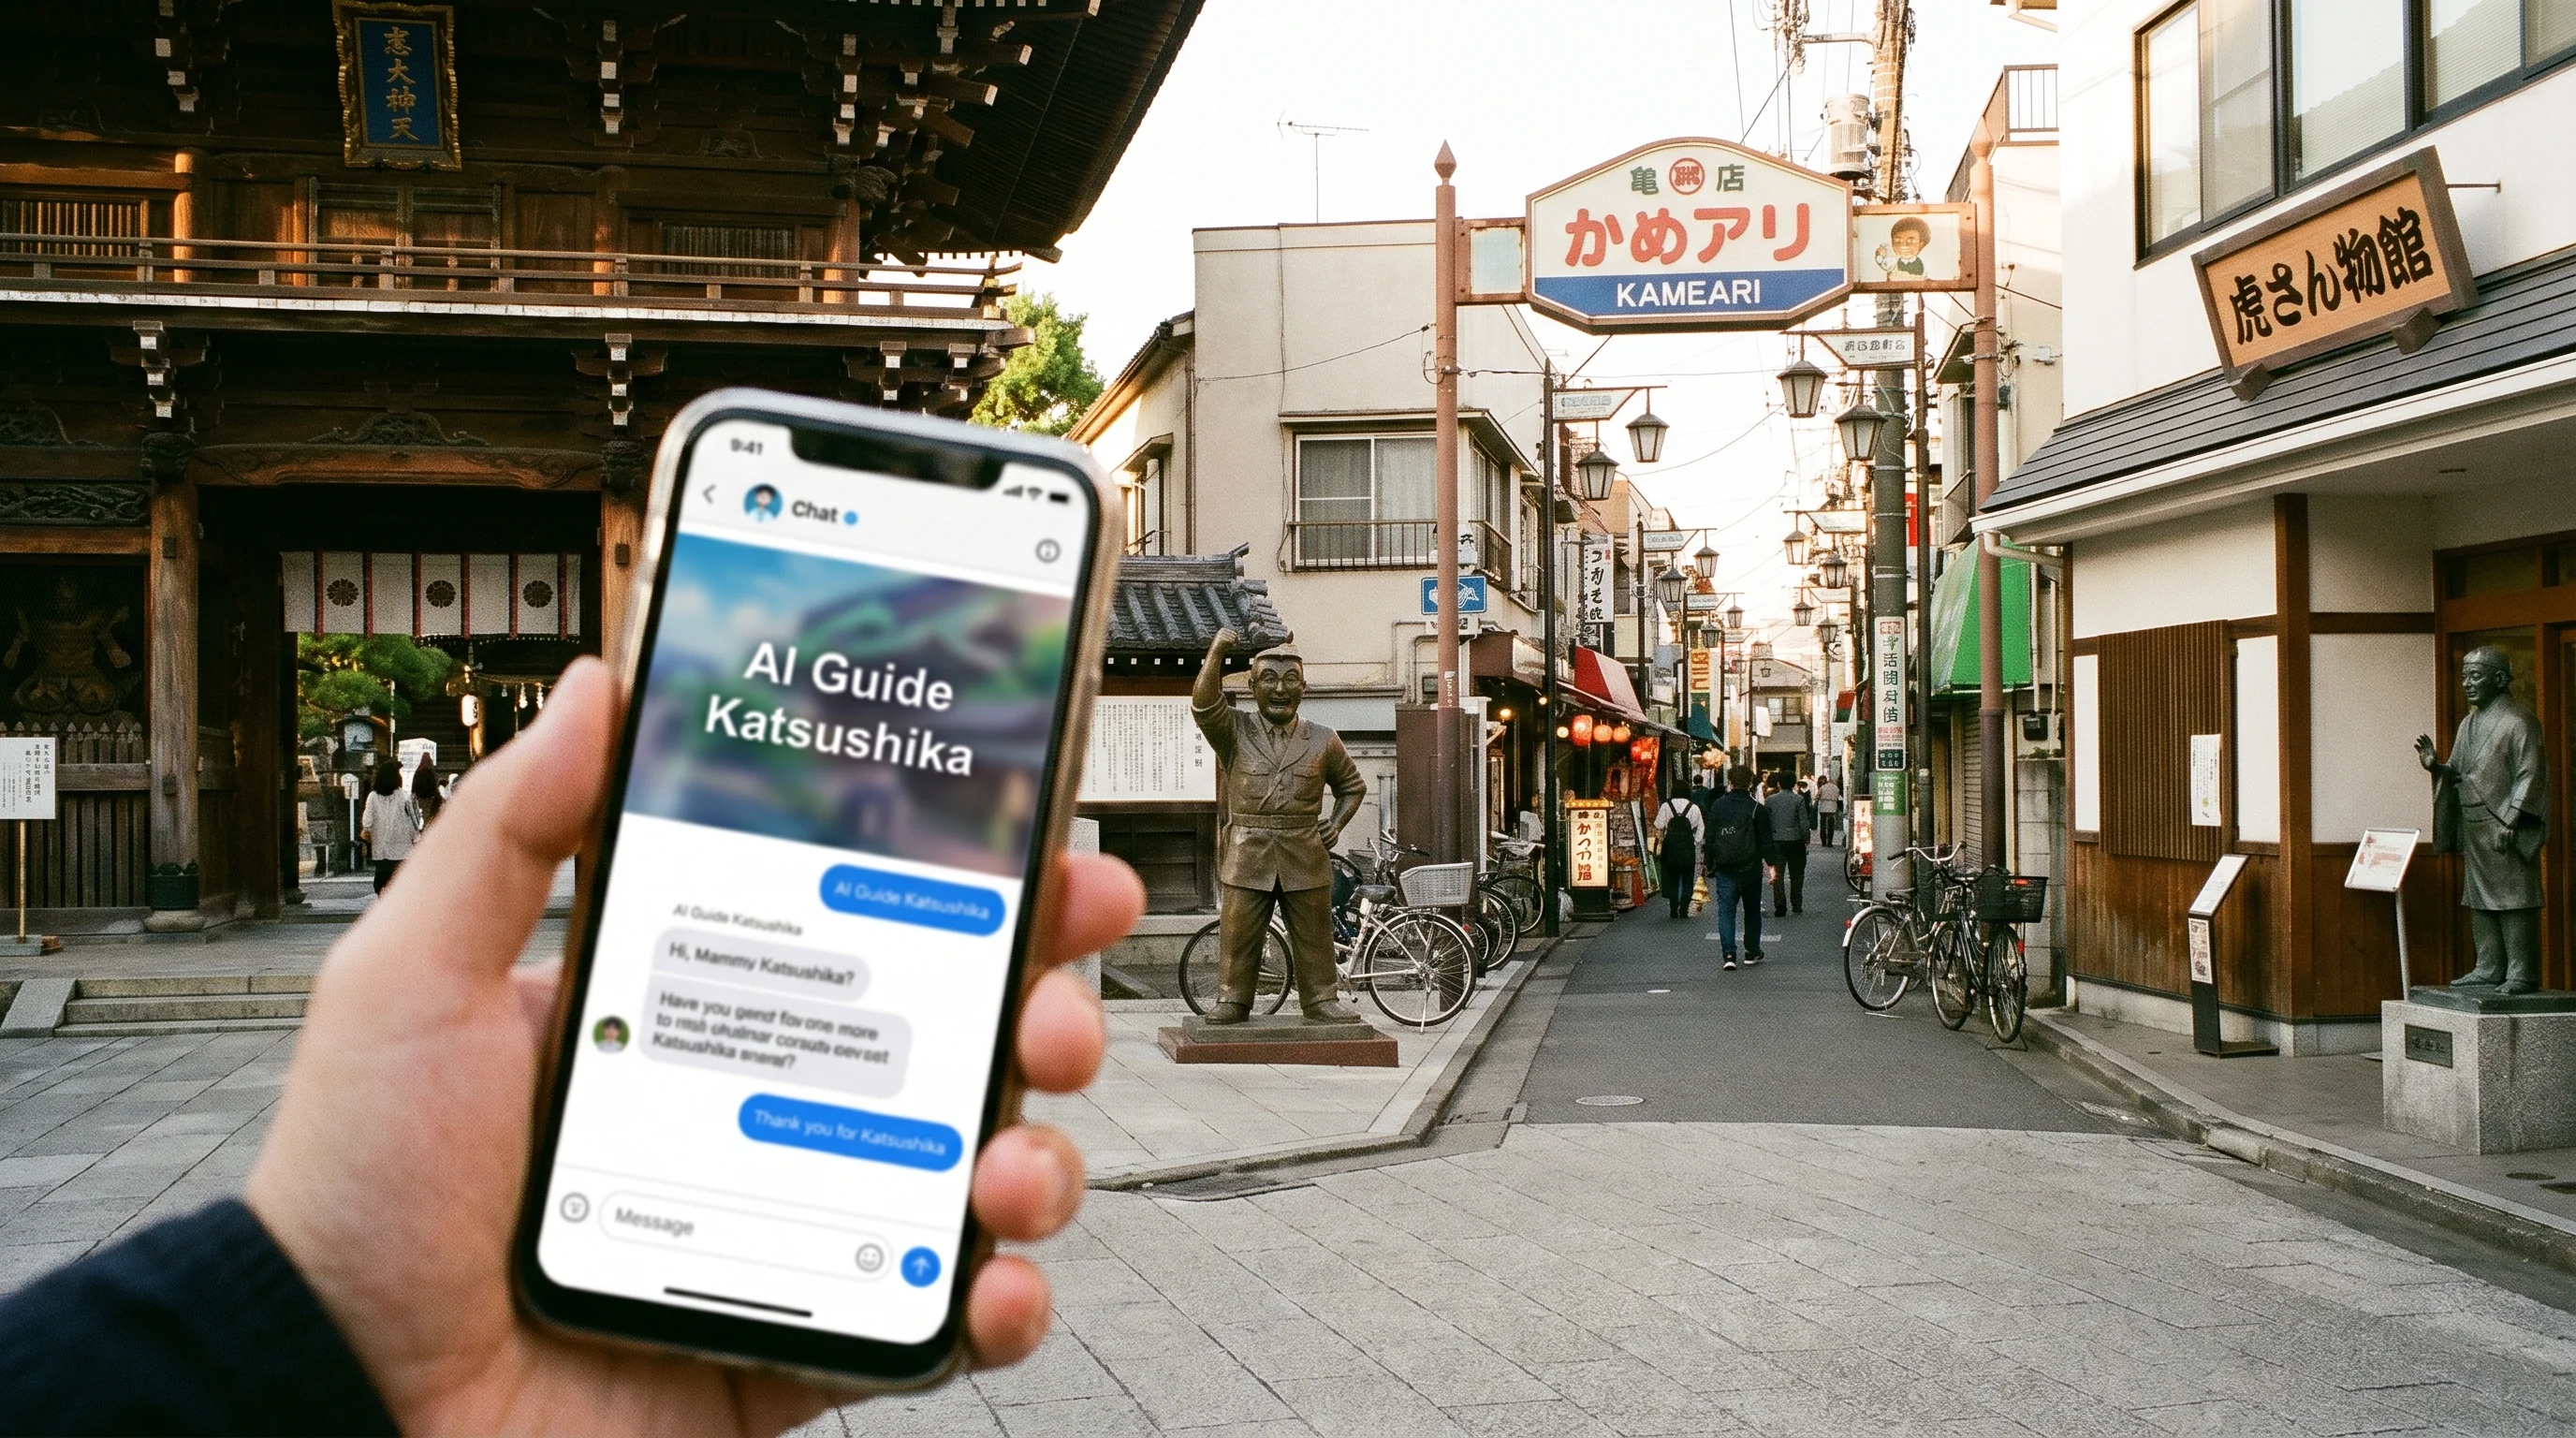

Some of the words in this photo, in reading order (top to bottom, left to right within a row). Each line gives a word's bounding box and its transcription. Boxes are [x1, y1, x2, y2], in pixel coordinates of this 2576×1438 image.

[1716, 163, 1746, 193] 店
[1564, 201, 1810, 268] かめアリ
[2229, 205, 2434, 346] 虎さん物館
[1616, 278, 1762, 309] KAMEARI
[730, 437, 764, 456] 9:41
[791, 499, 839, 524] Chat
[743, 641, 798, 686] AI
[812, 652, 954, 712] Guide
[705, 694, 974, 777] Katsushika
[834, 881, 852, 898] AI
[855, 882, 901, 907] Guide
[904, 891, 990, 921] Katsushika
[672, 903, 689, 917] AI
[691, 905, 730, 925] Guide
[732, 912, 804, 936] Katsushika
[668, 941, 691, 962] Hi,
[695, 947, 757, 973] Mammy
[759, 957, 855, 987] Katsushika?
[658, 991, 699, 1012] Have
[702, 1001, 732, 1018] you
[651, 1031, 737, 1059] Katsushika
[754, 1108, 800, 1132] Thank
[804, 1120, 833, 1137] you
[836, 1123, 858, 1141] for
[859, 1128, 946, 1157] Katsushika
[614, 1205, 695, 1240] Message
